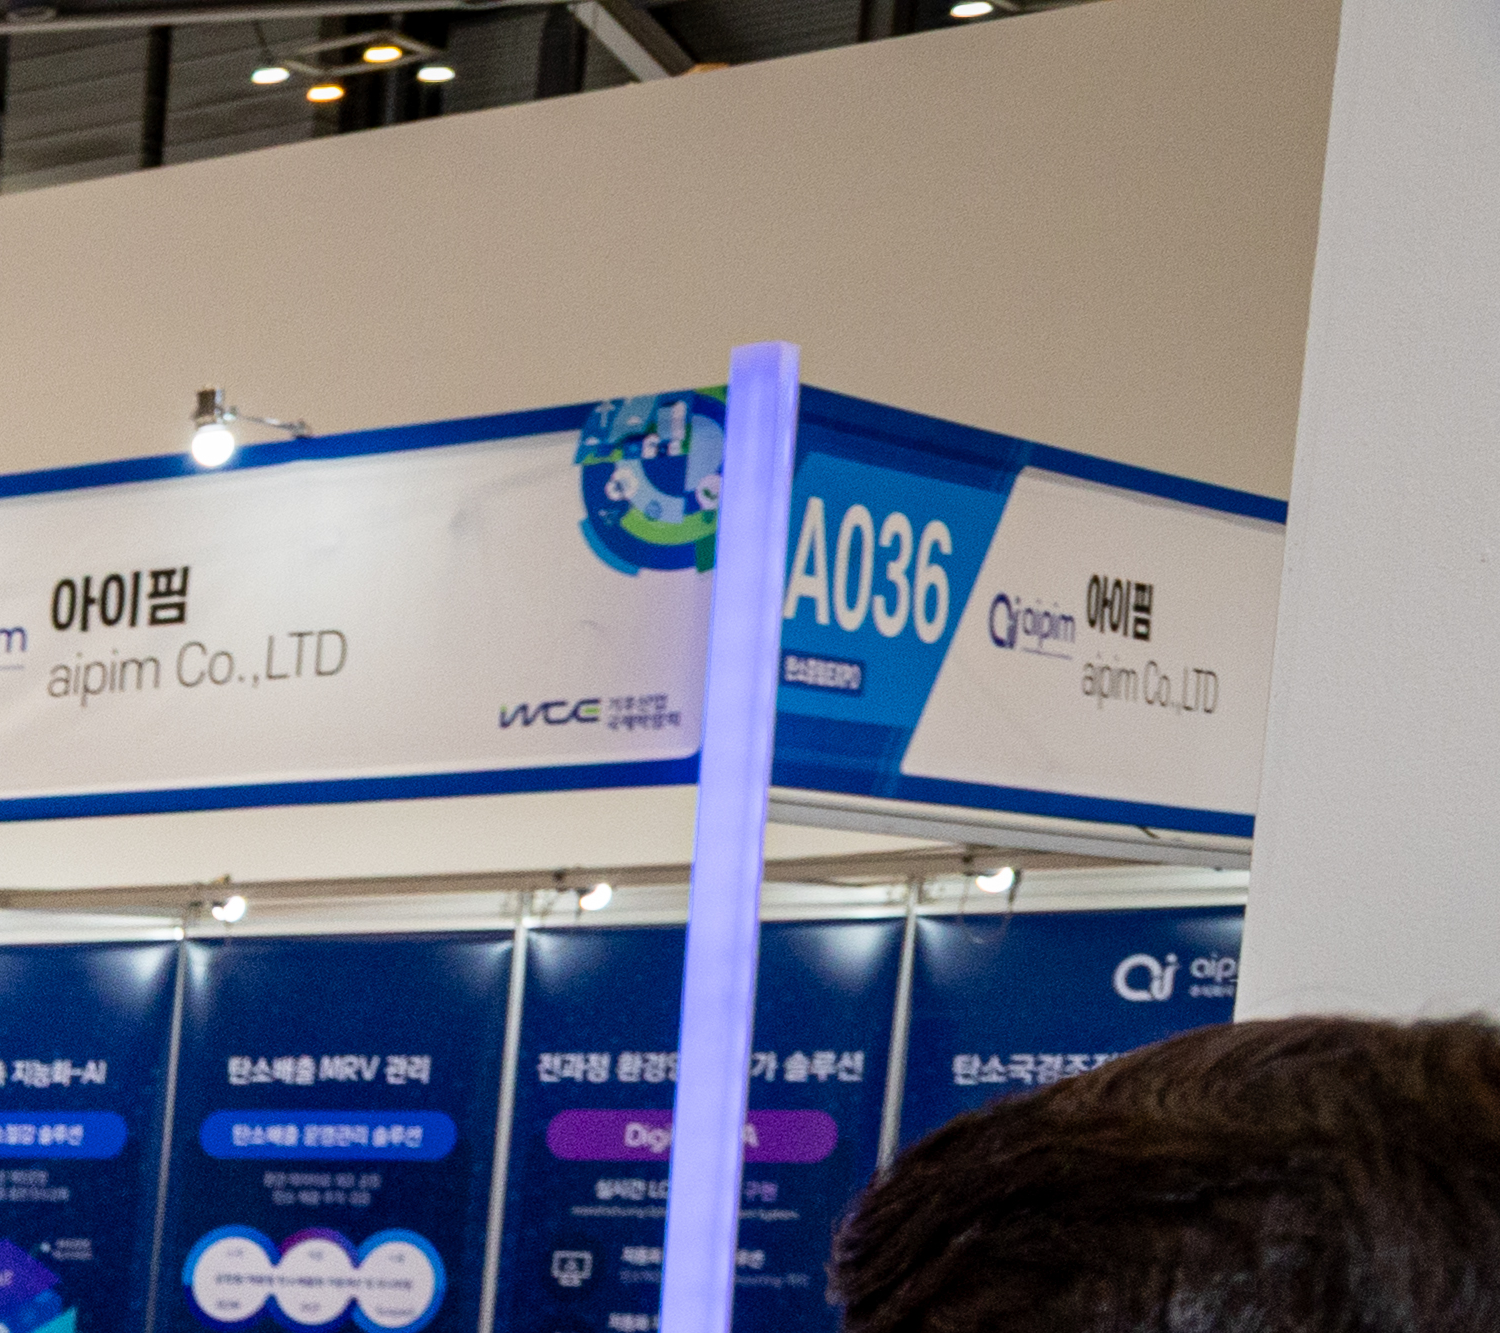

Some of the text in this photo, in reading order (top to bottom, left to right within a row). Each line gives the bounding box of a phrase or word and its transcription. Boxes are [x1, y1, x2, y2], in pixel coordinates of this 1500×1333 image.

[51, 567, 191, 632] 아이핌
[781, 497, 952, 644] A036
[1086, 574, 1154, 642] 아이핌
[47, 628, 348, 707] aipim Co.,LTD
[1082, 652, 1137, 709] aipim
[319, 1056, 378, 1082] MRV
[384, 1055, 431, 1084] 관리
[783, 1051, 864, 1082] 솔루션
